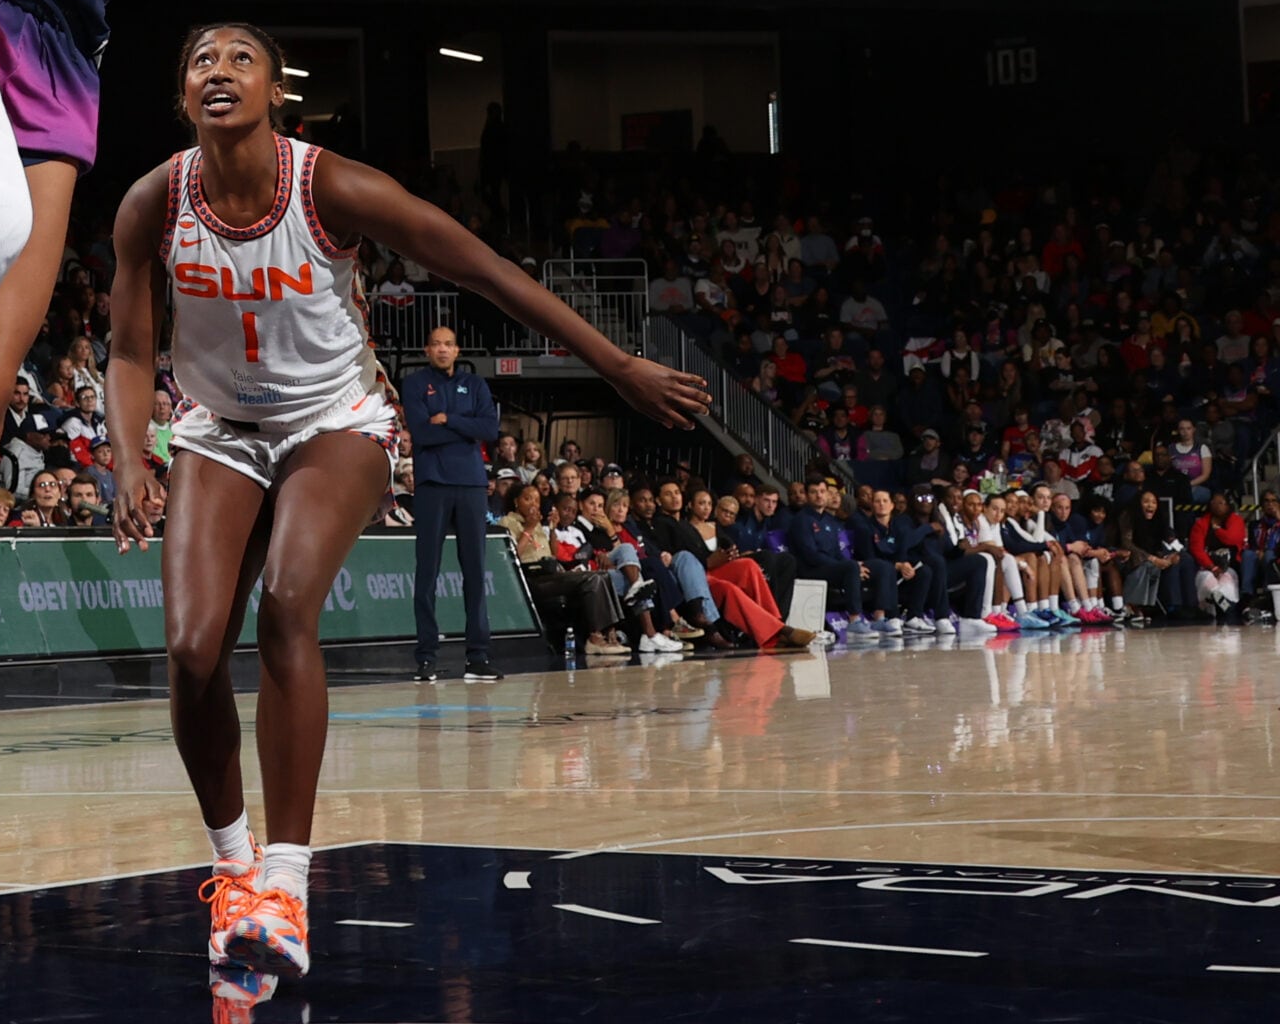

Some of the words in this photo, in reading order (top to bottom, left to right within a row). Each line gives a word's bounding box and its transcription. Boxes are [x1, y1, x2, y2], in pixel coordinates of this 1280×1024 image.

[987, 46, 1037, 87] 109
[174, 262, 314, 301] SUN
[242, 311, 259, 363] 1
[230, 368, 254, 383] Yale
[500, 358, 518, 373] EXIT
[237, 390, 281, 405] Health
[18, 581, 69, 612] OBEY
[69, 580, 124, 609] YOUR
[366, 573, 405, 600] OBEY
